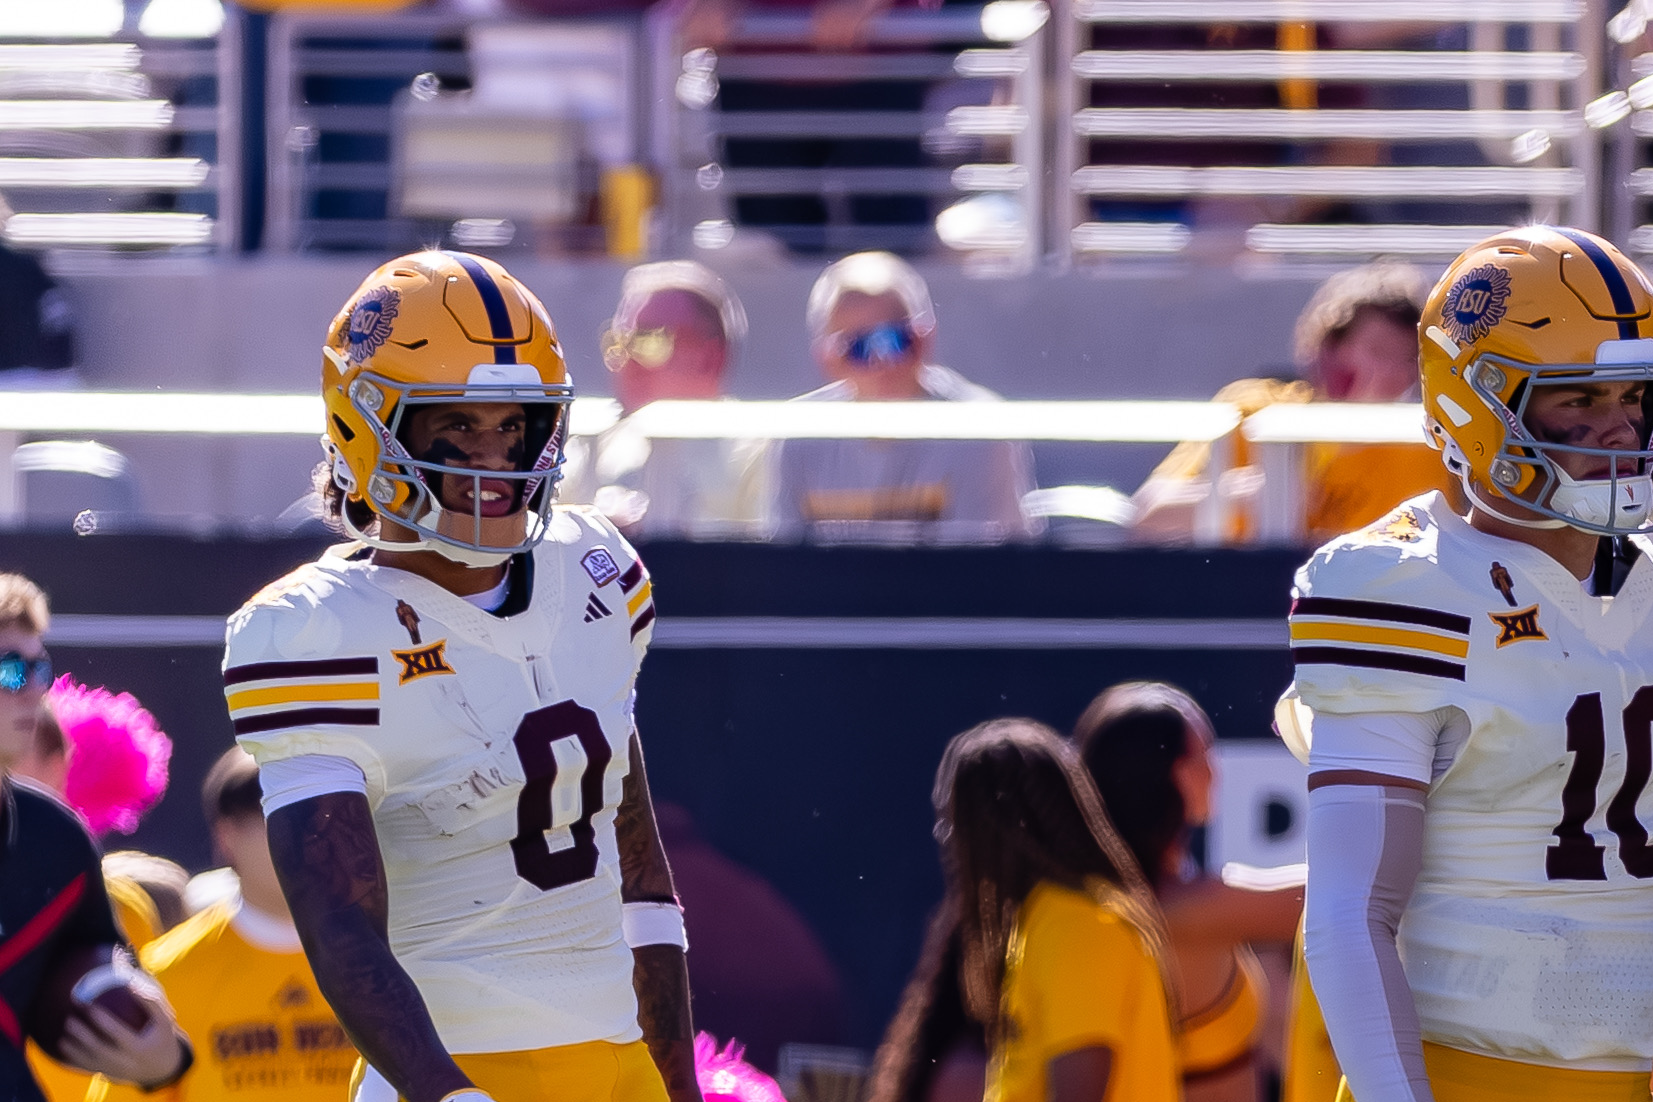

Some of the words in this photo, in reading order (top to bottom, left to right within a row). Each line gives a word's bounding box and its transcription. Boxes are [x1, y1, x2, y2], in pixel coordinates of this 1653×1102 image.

[1456, 289, 1490, 314] ASU
[1488, 604, 1549, 649] XII
[391, 639, 456, 685] XII
[510, 699, 612, 892] 0
